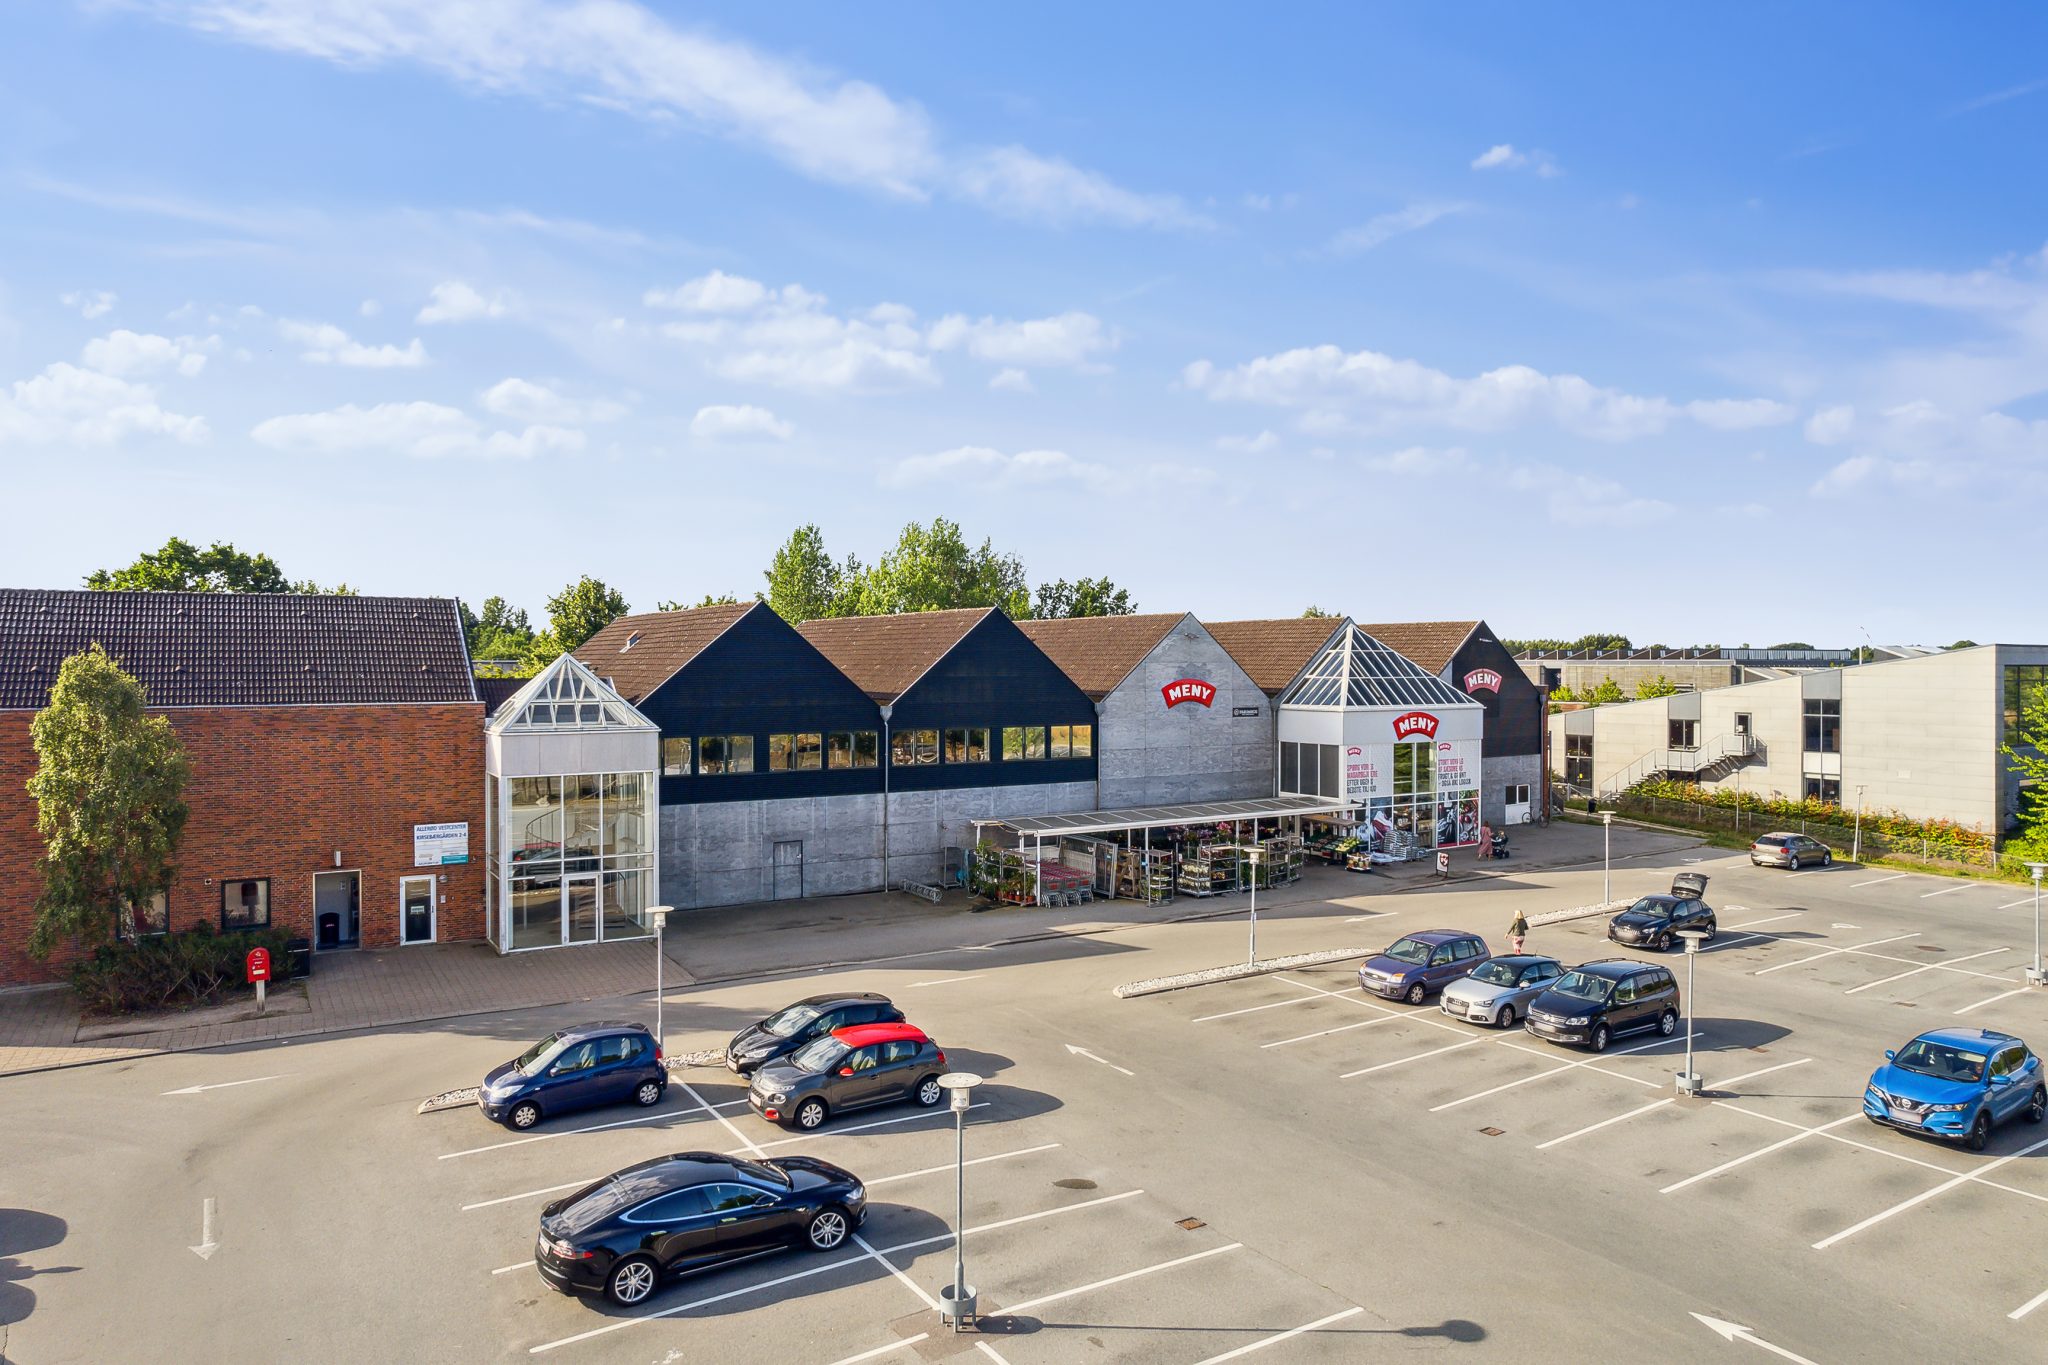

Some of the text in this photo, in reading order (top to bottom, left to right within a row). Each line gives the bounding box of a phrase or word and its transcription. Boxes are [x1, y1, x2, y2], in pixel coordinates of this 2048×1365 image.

[1468, 673, 1498, 688] MENY
[1168, 684, 1211, 701] MENY
[1398, 716, 1435, 734] MENY
